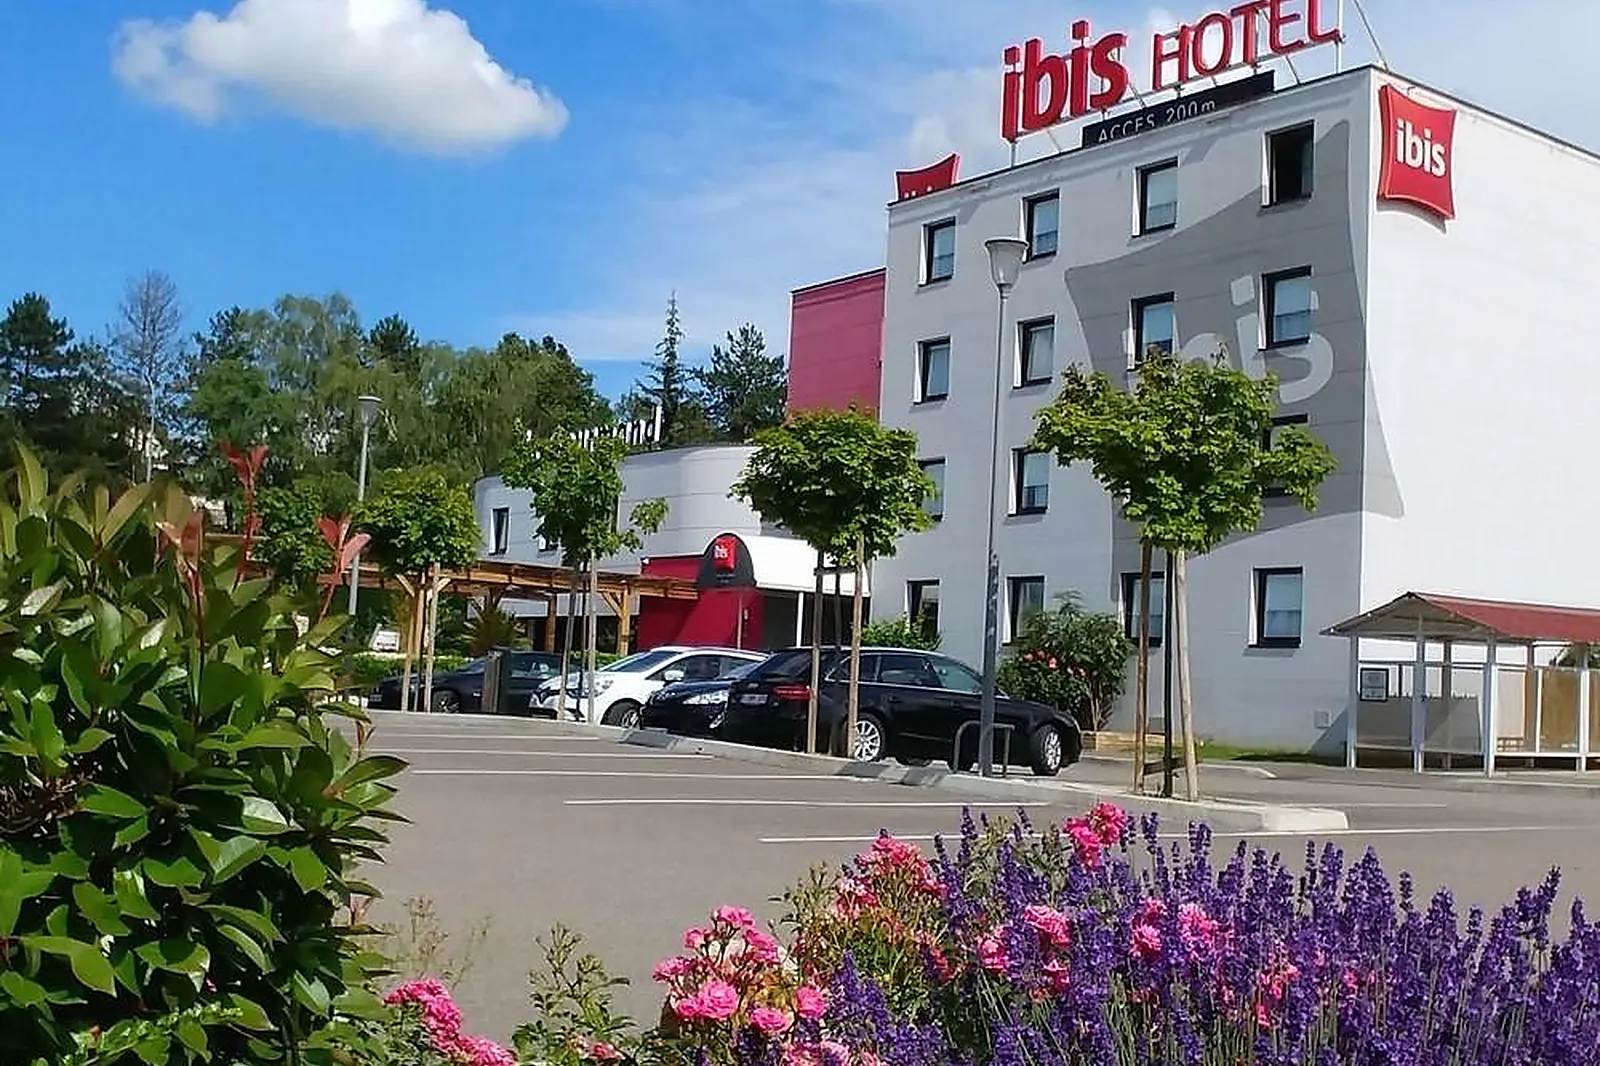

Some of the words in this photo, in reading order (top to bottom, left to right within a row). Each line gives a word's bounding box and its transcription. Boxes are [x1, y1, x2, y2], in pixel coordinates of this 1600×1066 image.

[1001, 20, 1129, 142] ibis
[1152, 0, 1341, 92] HOTEL
[1396, 117, 1446, 178] ibis
